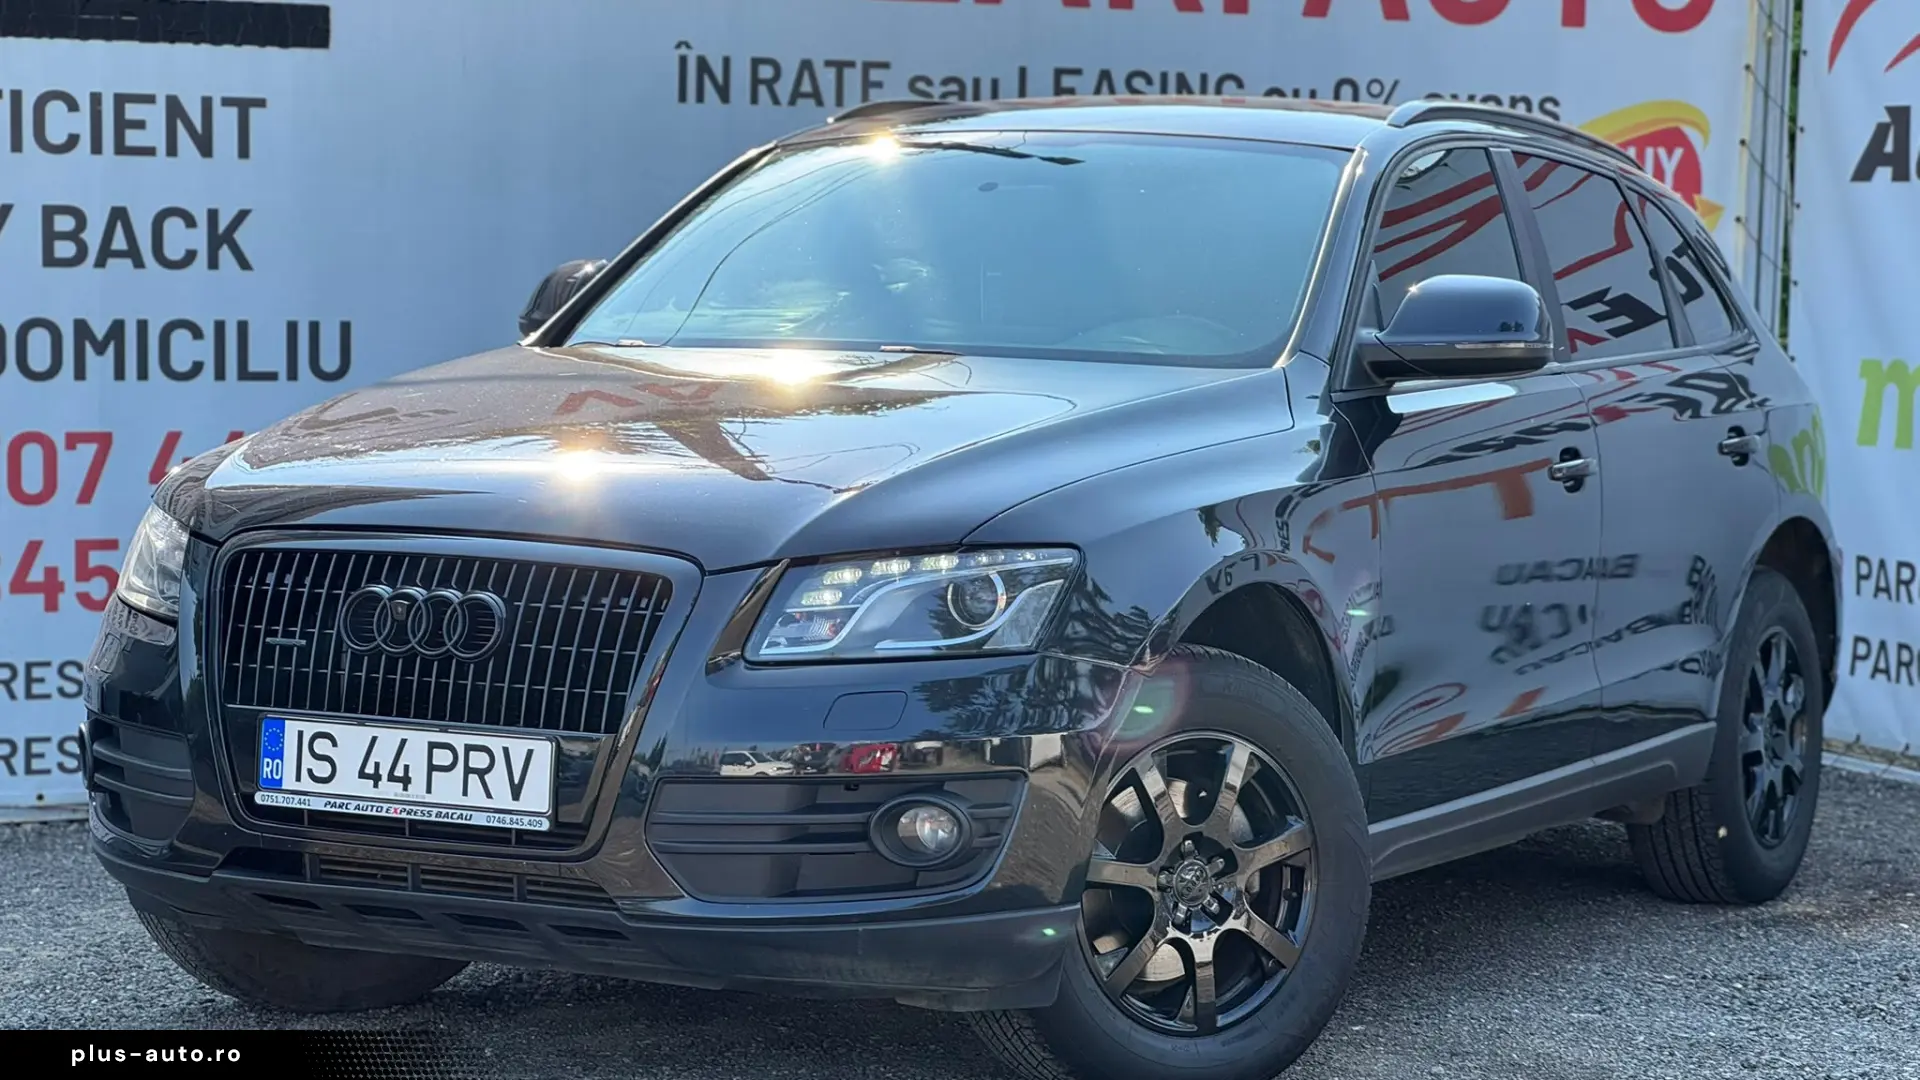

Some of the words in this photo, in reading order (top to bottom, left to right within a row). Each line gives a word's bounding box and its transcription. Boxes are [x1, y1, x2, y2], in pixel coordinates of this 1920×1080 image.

[673, 40, 731, 104] ÎN
[749, 57, 891, 107] RATE
[0, 88, 267, 160] ICIENT
[1849, 104, 1920, 183] A
[41, 204, 254, 271] BACK
[0, 316, 352, 383] OMICILIU
[0, 538, 121, 613] 45
[1855, 555, 1920, 604] PAR
[1848, 635, 1920, 687] PAR
[263, 757, 283, 780] RO
[294, 729, 339, 785] IS
[357, 735, 412, 792] 44
[425, 740, 535, 802] PRV
[260, 794, 312, 808] 0751.707.441
[323, 800, 354, 812] PARC
[353, 804, 384, 814] AUTO
[385, 806, 433, 819] EXPRESS
[434, 810, 473, 822] BACAU
[485, 815, 543, 829] 0746.845.409
